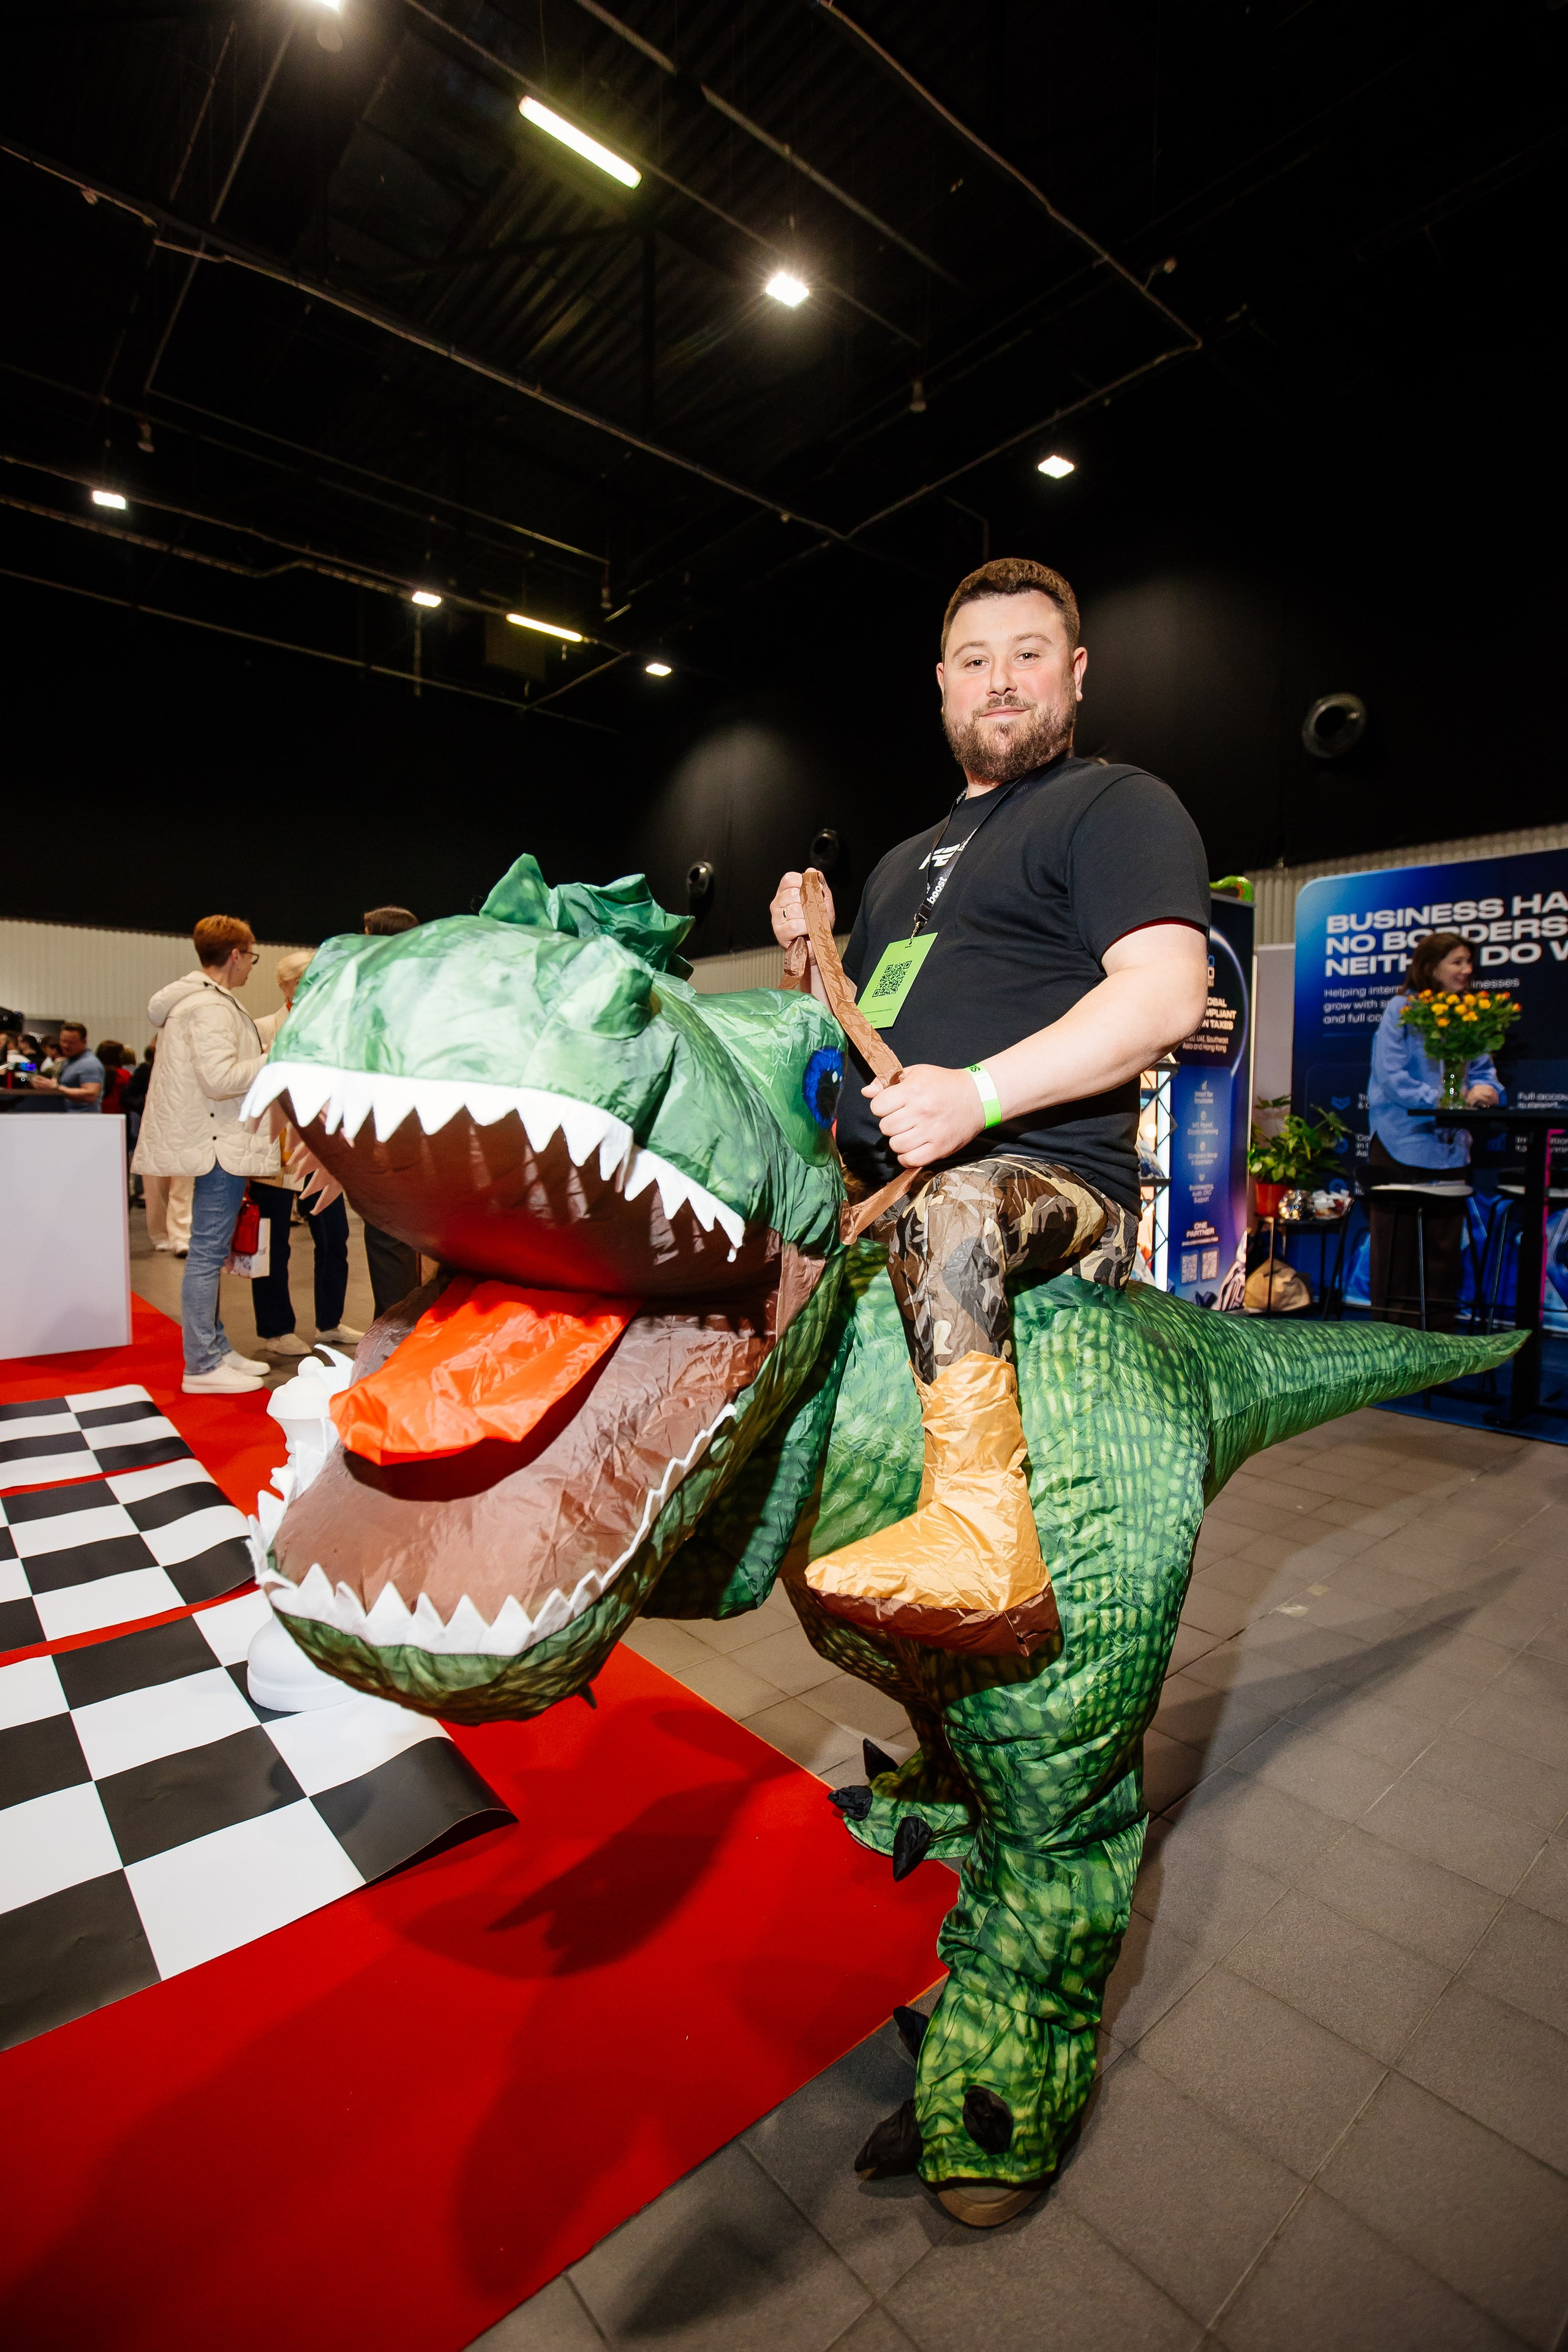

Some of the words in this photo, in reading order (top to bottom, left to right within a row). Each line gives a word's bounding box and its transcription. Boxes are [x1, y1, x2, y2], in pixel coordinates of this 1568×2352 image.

[927, 876, 948, 905] boost
[1326, 898, 1504, 934] BUSINESS
[1325, 933, 1376, 956] NO
[1382, 915, 1568, 951] BODERS
[1479, 943, 1542, 967] DO
[1324, 987, 1366, 998] Helping
[1323, 1002, 1352, 1014] grow
[1352, 999, 1378, 1010] with
[1210, 1020, 1234, 1030] TAXES
[1323, 1014, 1346, 1025] and
[1348, 1012, 1365, 1023] full
[1203, 1044, 1215, 1054] Hong
[1215, 1044, 1227, 1054] Kong
[1194, 1221, 1208, 1230] ONE
[1186, 1227, 1215, 1238] PARTNER
